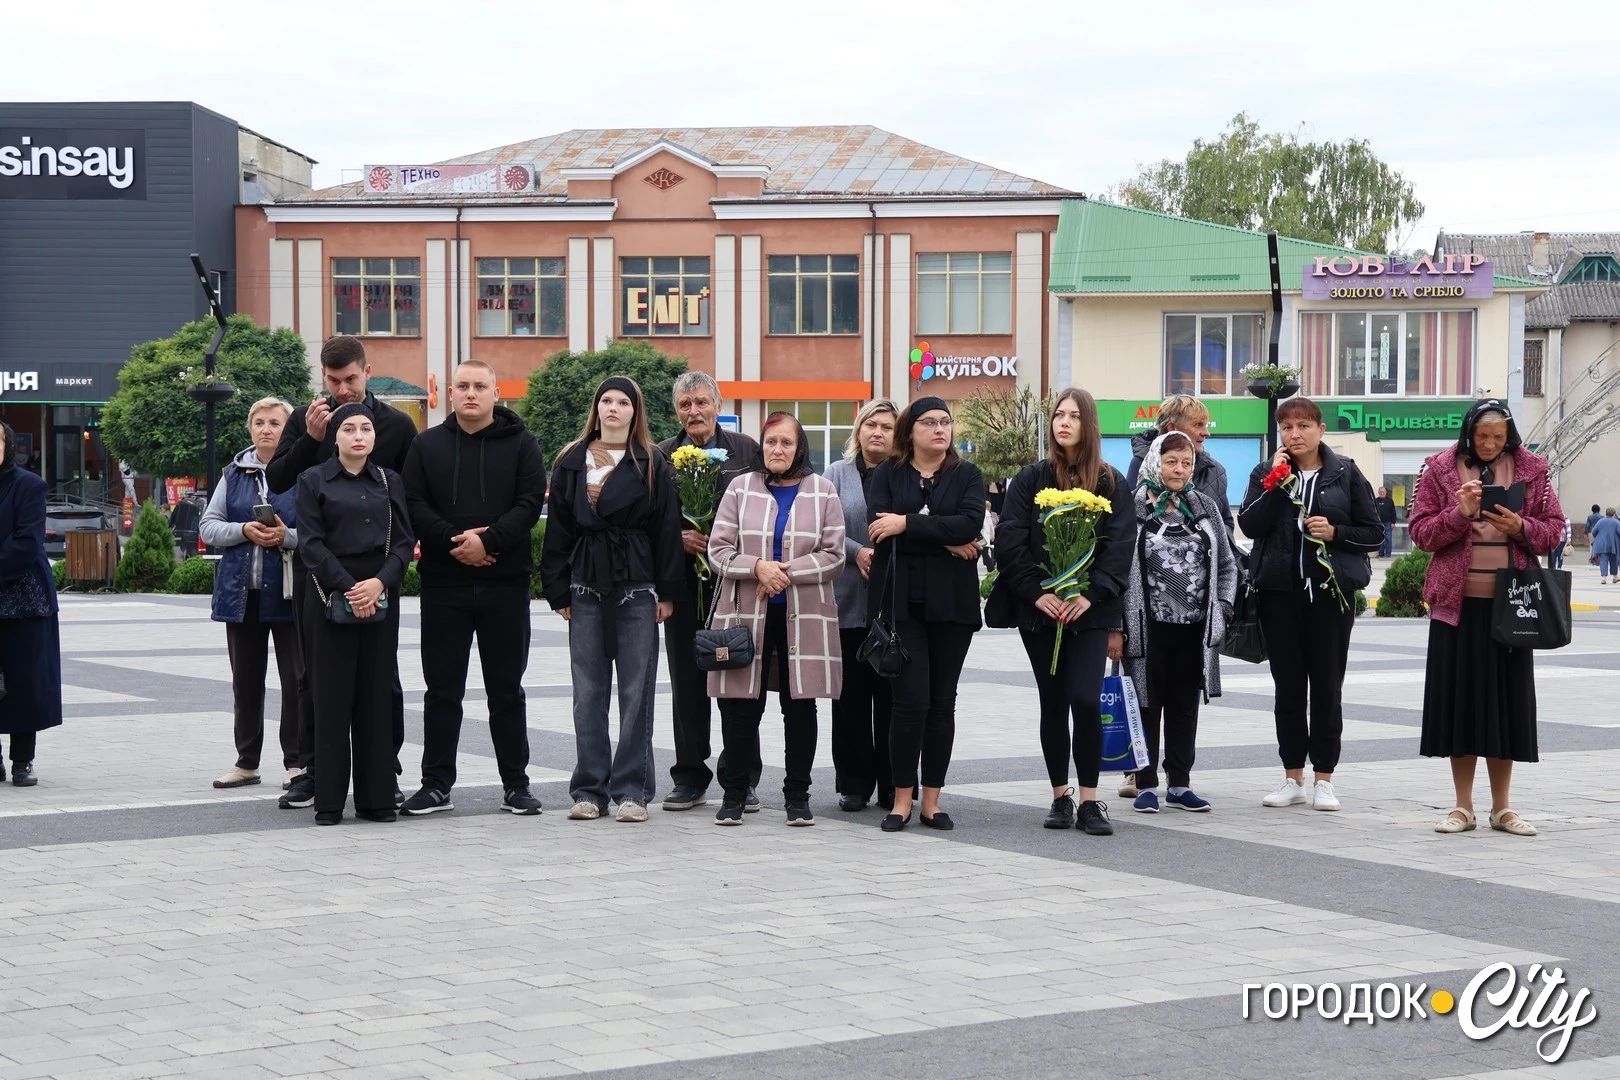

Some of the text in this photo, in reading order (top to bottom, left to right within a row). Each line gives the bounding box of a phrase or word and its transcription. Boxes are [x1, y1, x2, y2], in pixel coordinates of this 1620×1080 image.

[0, 136, 134, 189] sinsay
[1312, 254, 1485, 276] ЮВЕЛІР
[1330, 286, 1465, 298] ЗОЛОТО ТА СРІБЛО
[477, 299, 529, 310] ВІДЕО
[936, 355, 982, 363] МАЙСТЕРНЯ
[55, 378, 93, 386] маркет
[1365, 413, 1463, 432] ПриватБ
[1131, 716, 1140, 739] нами
